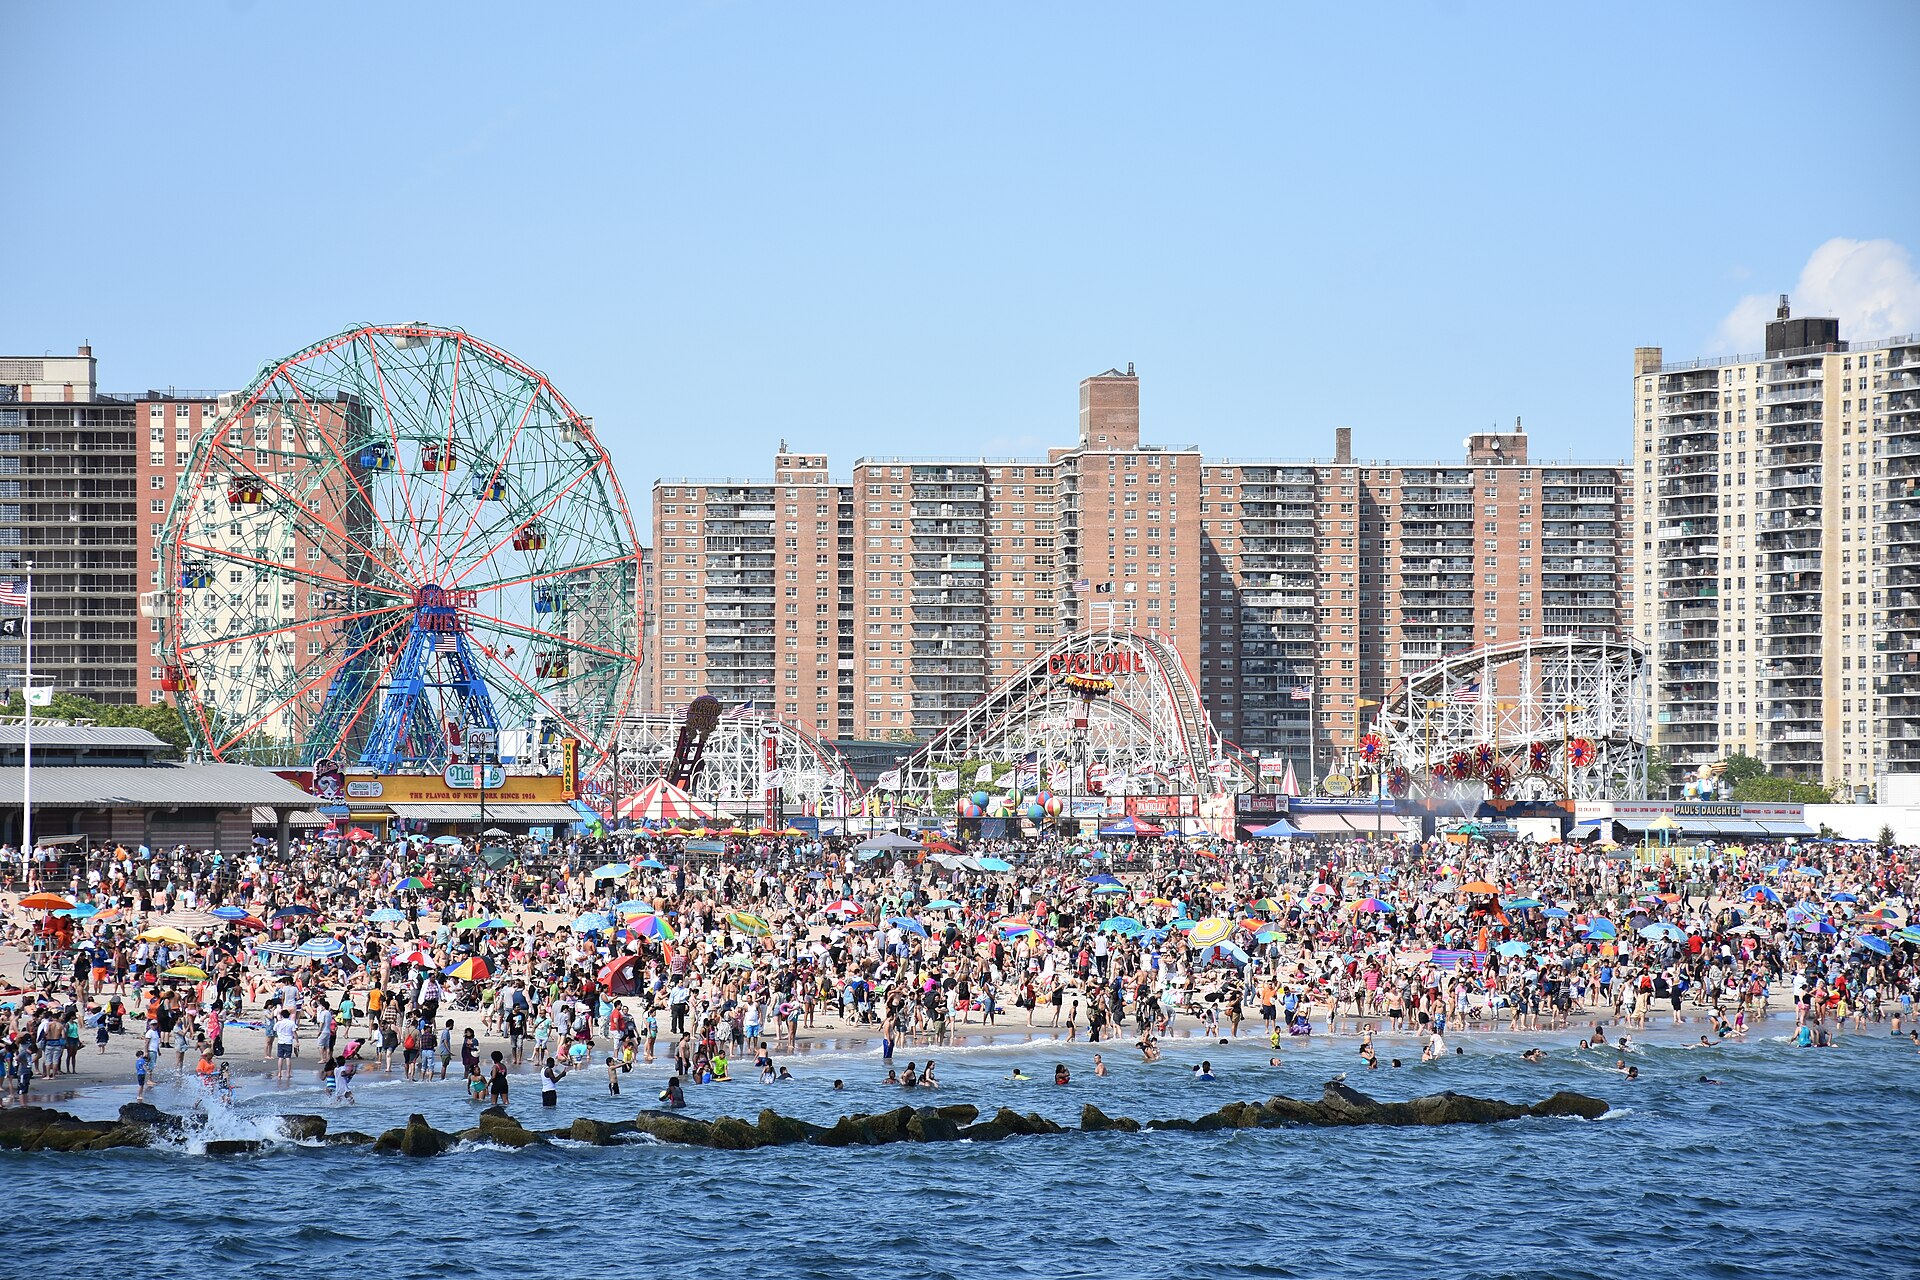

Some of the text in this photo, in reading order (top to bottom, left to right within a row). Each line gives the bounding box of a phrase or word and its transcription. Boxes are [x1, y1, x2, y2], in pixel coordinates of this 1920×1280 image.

[412, 589, 477, 608] WONDER
[418, 612, 473, 631] WHEEL
[1049, 652, 1145, 675] CYCLONE
[1675, 806, 1740, 816] PAUL'S DAUGHTER
